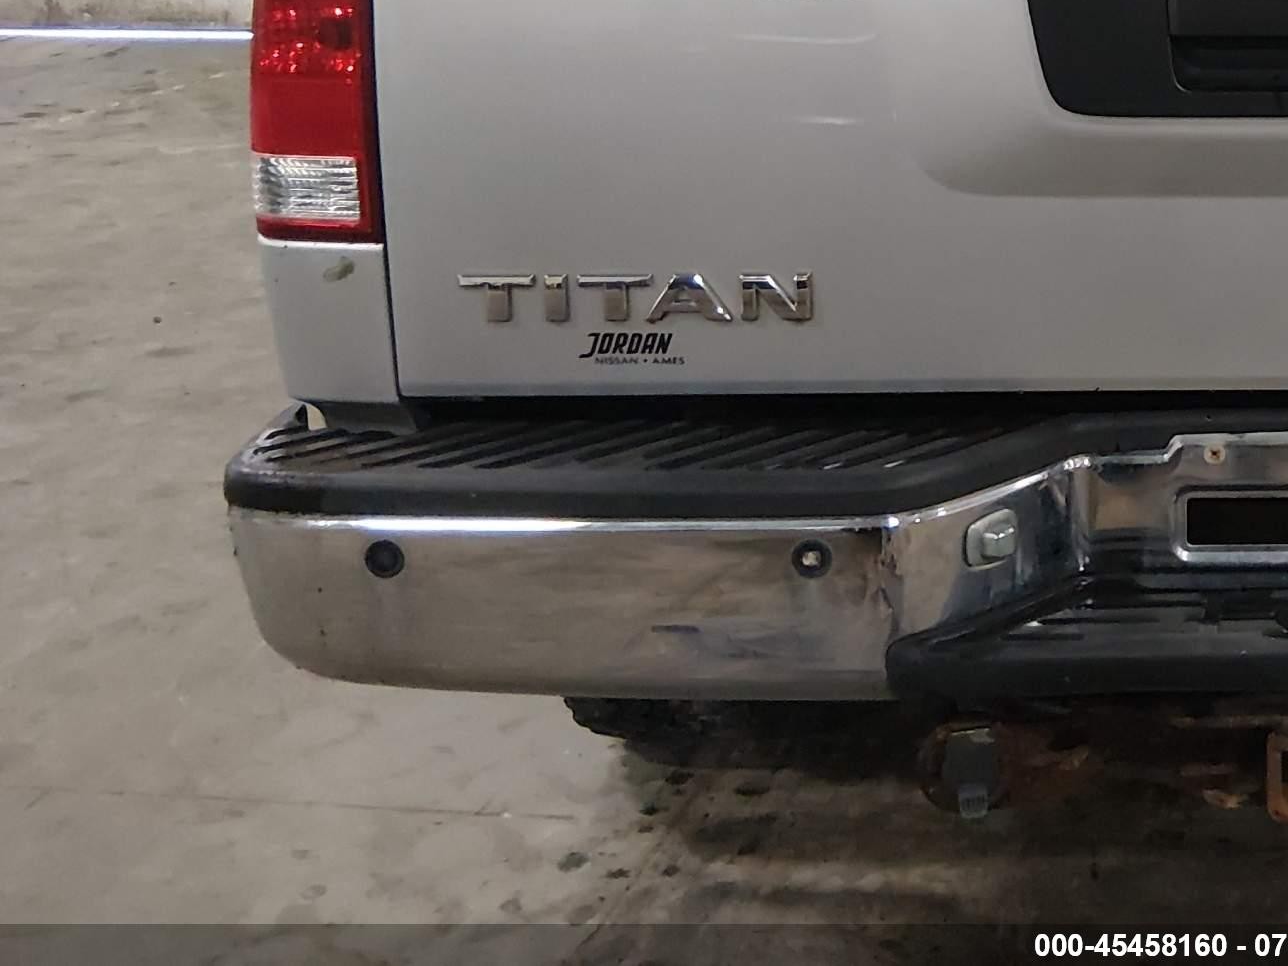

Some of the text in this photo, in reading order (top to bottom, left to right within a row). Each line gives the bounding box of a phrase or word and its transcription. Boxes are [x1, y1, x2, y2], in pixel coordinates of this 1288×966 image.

[457, 273, 814, 323] TITAN
[579, 333, 673, 359] JORDAN
[595, 357, 685, 365] NISSAN AMES
